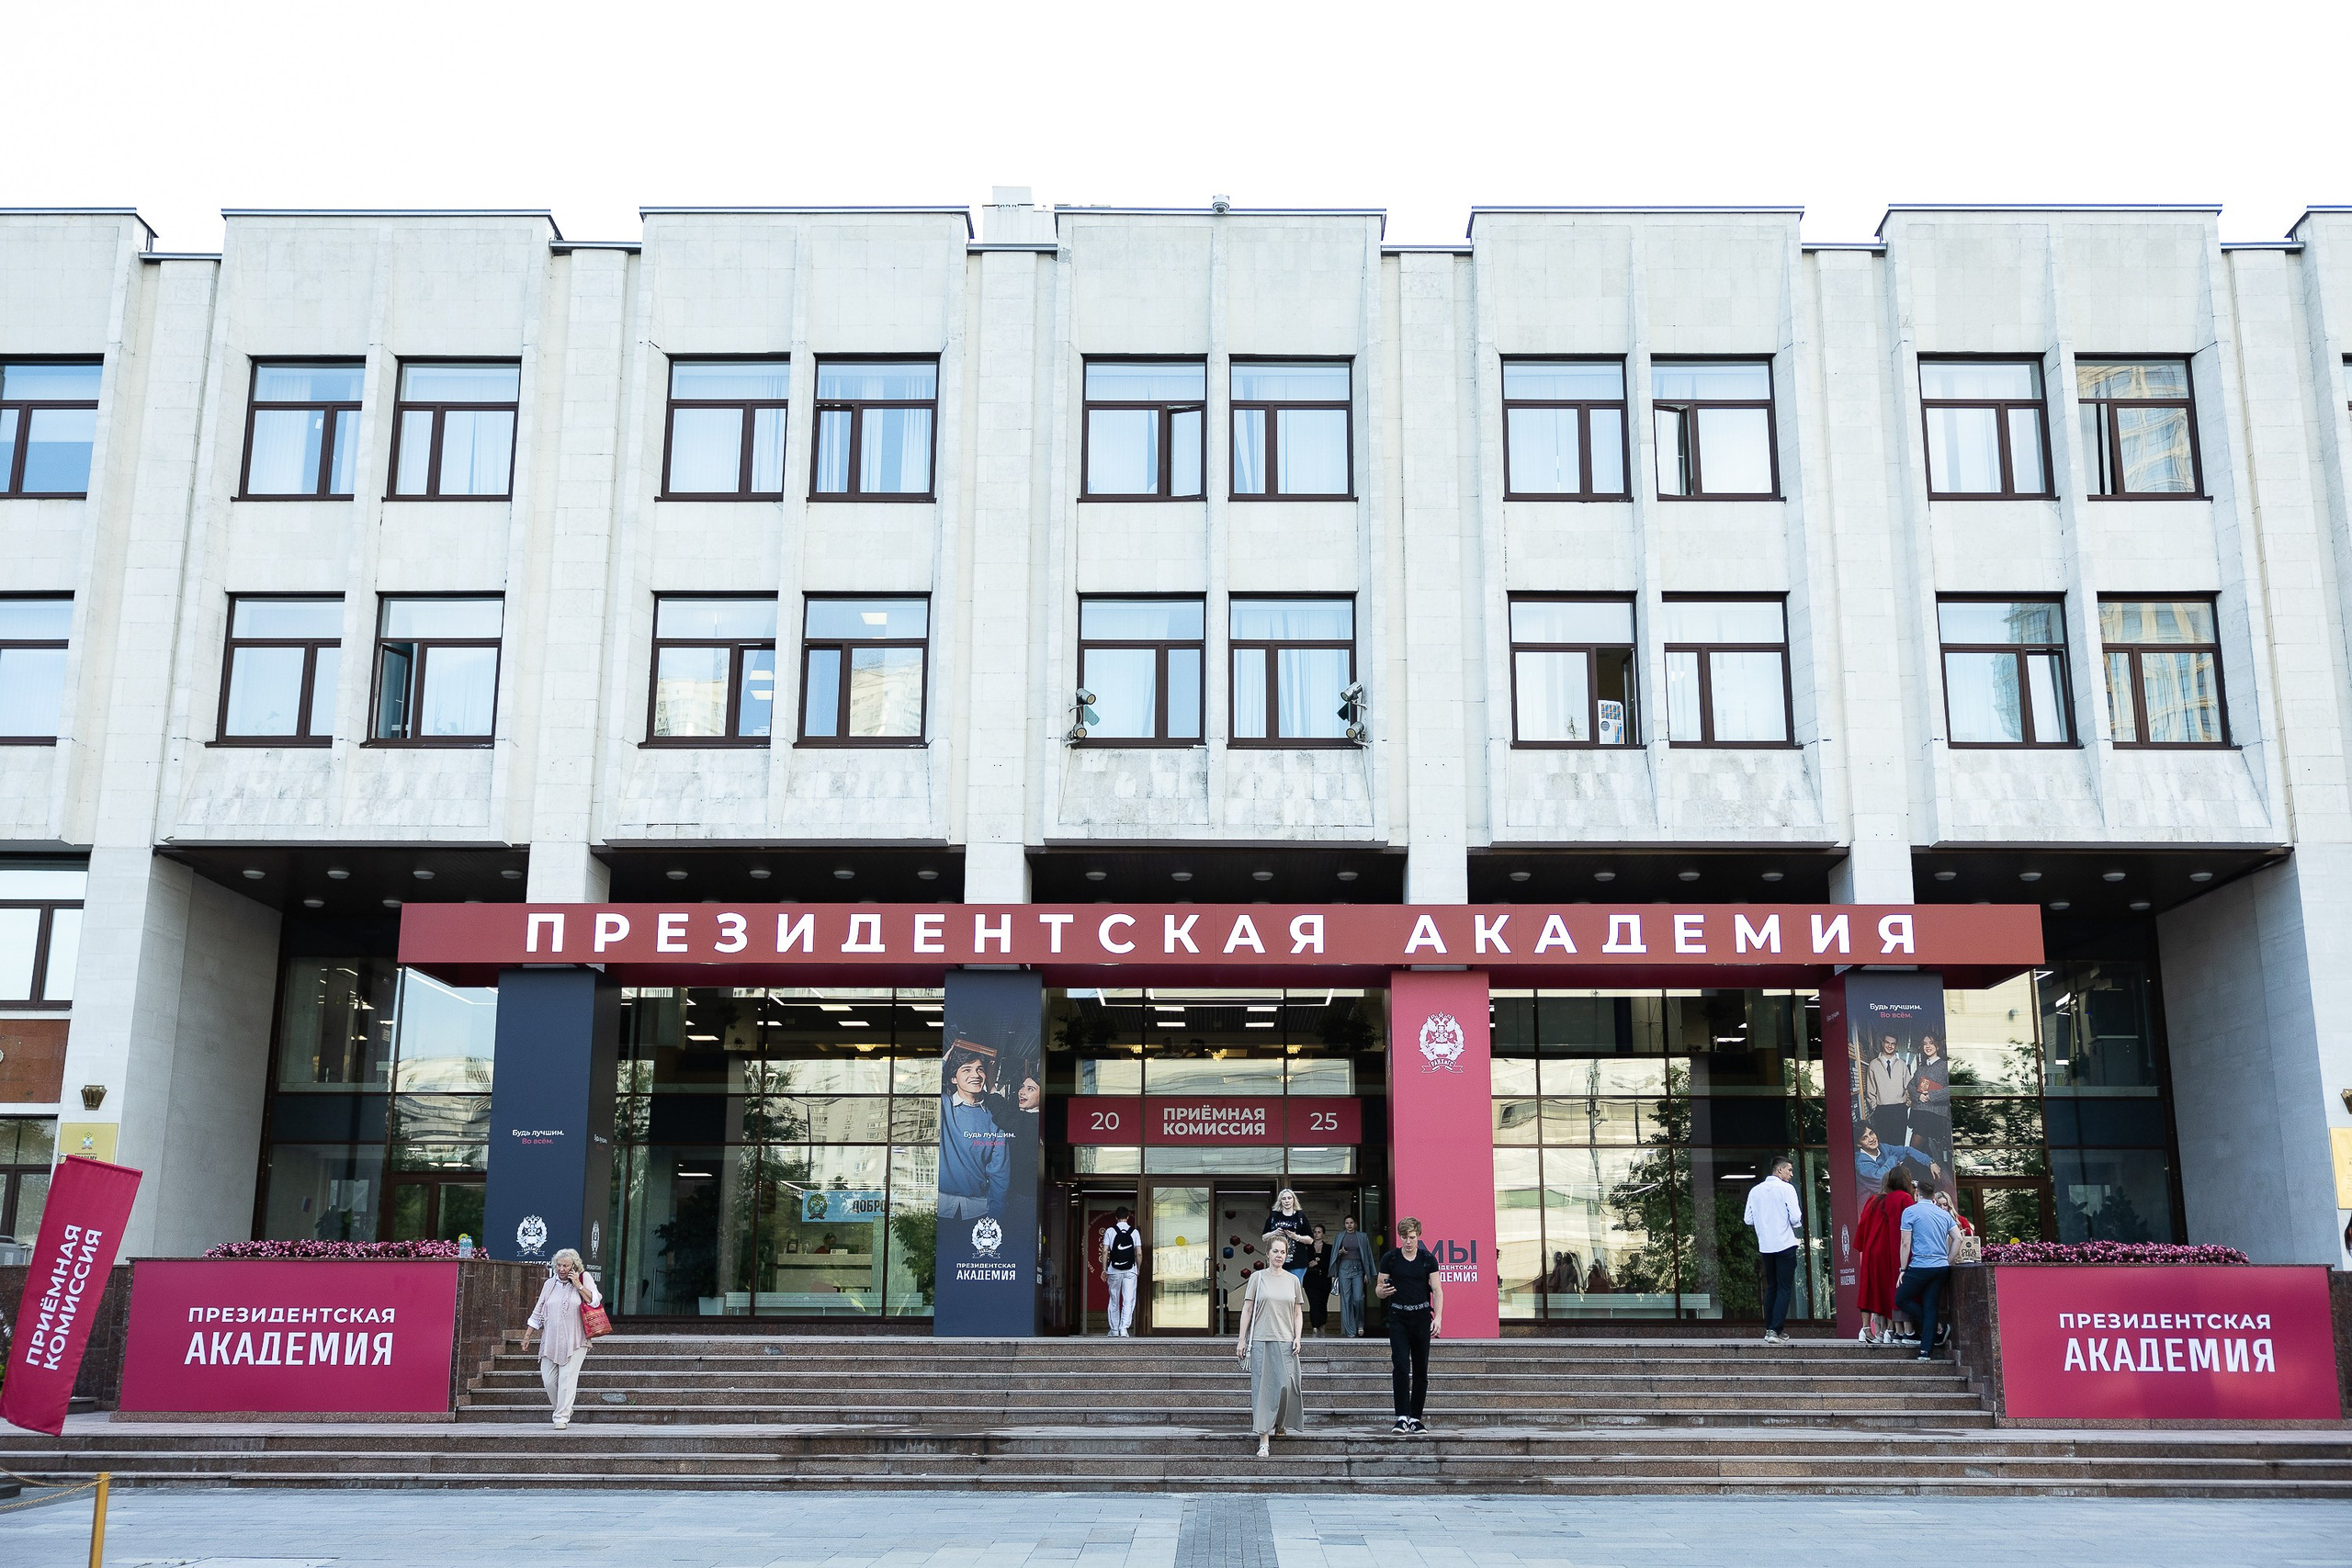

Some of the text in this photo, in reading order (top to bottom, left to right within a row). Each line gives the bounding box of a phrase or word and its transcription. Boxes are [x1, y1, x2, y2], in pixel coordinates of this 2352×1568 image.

[526, 912, 1916, 954] ПРЕЗИДЕНТСКАЯ АКАДЕМИЯ
[1091, 1111, 1120, 1130] 20
[1163, 1104, 1265, 1121] ПРИЁМНАЯ
[1309, 1112, 1339, 1131] 25
[512, 1129, 530, 1137] Будь
[1163, 1122, 1265, 1135] КОМИССИЯ
[956, 1269, 1016, 1280] АКАДЕМИЯ
[26, 1224, 82, 1366] ПРИЁМНАЯ
[43, 1229, 102, 1371] КОМИССИЯ
[187, 1307, 395, 1323] ПРЕЗИДЕНТСКАЯ
[2059, 1313, 2271, 1329] ПРЕЗИДЕНТСКАЯ
[183, 1331, 394, 1366] АКАДЕМИЯ
[2064, 1337, 2276, 1372] АКАДЕМИЯ
